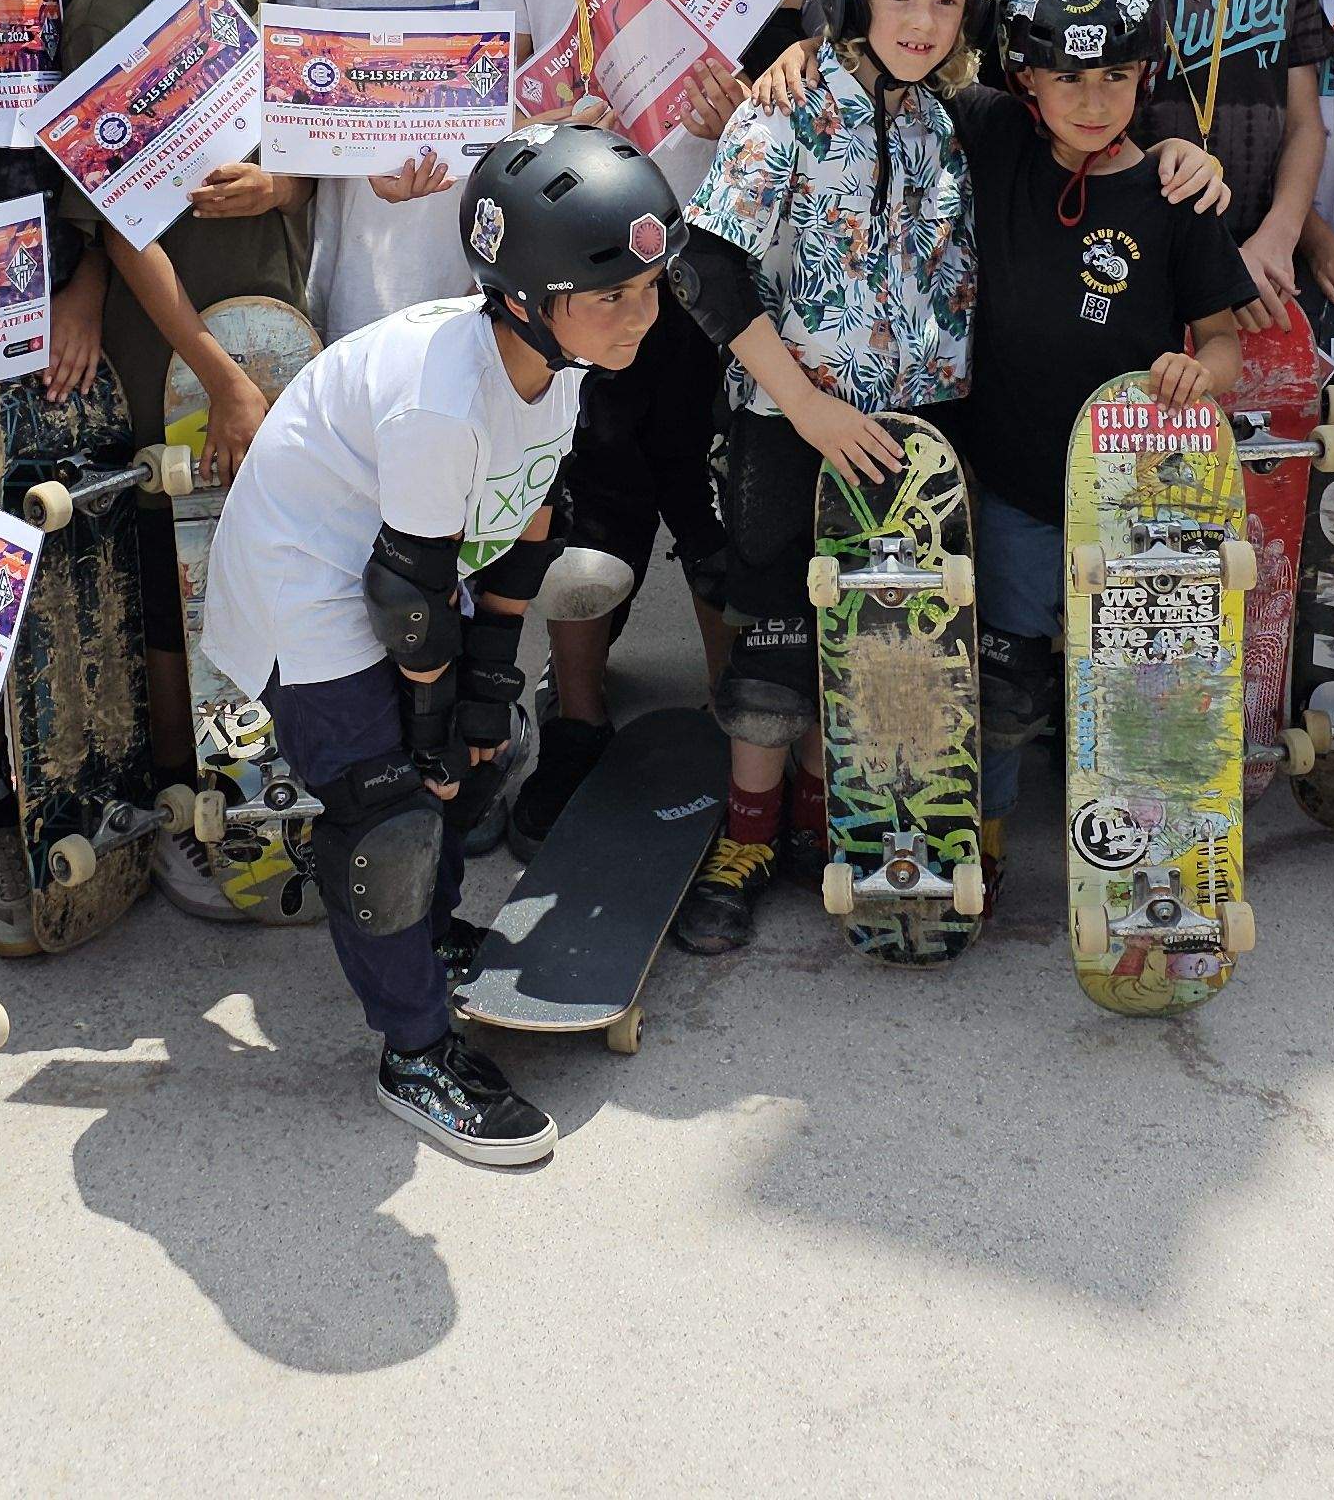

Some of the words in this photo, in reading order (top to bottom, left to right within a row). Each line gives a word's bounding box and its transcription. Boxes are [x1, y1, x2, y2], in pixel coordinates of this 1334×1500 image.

[697, 2, 712, 20] LA
[7, 32, 30, 42] 2024
[544, 44, 573, 77] Lliga
[132, 84, 160, 115] 13-15
[157, 63, 184, 94] SEPT.
[180, 46, 205, 71] 2024
[350, 69, 383, 81] 13-15
[385, 69, 414, 82] SEPT.
[419, 69, 450, 81] 2024
[265, 113, 334, 127] COMPETICIÓ
[336, 119, 374, 129] EXTRA
[376, 119, 392, 129] DE
[393, 119, 408, 129] LA
[409, 119, 443, 129] LLIGA
[444, 118, 481, 128] SKATE
[483, 117, 507, 127] BCN
[100, 155, 158, 210] COMPETICIÓ
[155, 131, 188, 163] EXTRA
[184, 120, 202, 137] DE
[197, 109, 213, 127] LA
[207, 88, 237, 118] LLIGA
[231, 68, 258, 96] SKATE
[142, 168, 168, 192] DINS
[175, 124, 217, 163] EXTREM
[210, 86, 259, 139] BARCELONA
[308, 129, 337, 140] DINS
[351, 131, 397, 142] EXTREM
[400, 131, 466, 142] BARCELONA
[1082, 228, 1114, 246] CLUB
[1116, 230, 1141, 260] PURO
[547, 280, 574, 291] oxelo
[1080, 270, 1128, 295] SKATEBOARD
[1087, 297, 1106, 310] SO
[23, 310, 45, 324] BCN
[1097, 406, 1150, 430] CLUB
[1156, 405, 1211, 430] PURO
[1098, 433, 1213, 452] SKATEBOARD
[1181, 530, 1202, 542] CLUB
[1100, 587, 1148, 608] we
[1156, 585, 1214, 608] are
[1099, 604, 1214, 625] SKATERS
[750, 616, 806, 634] 187
[746, 634, 780, 647] KILLER
[781, 633, 808, 646] PADS
[980, 634, 1011, 650] 87
